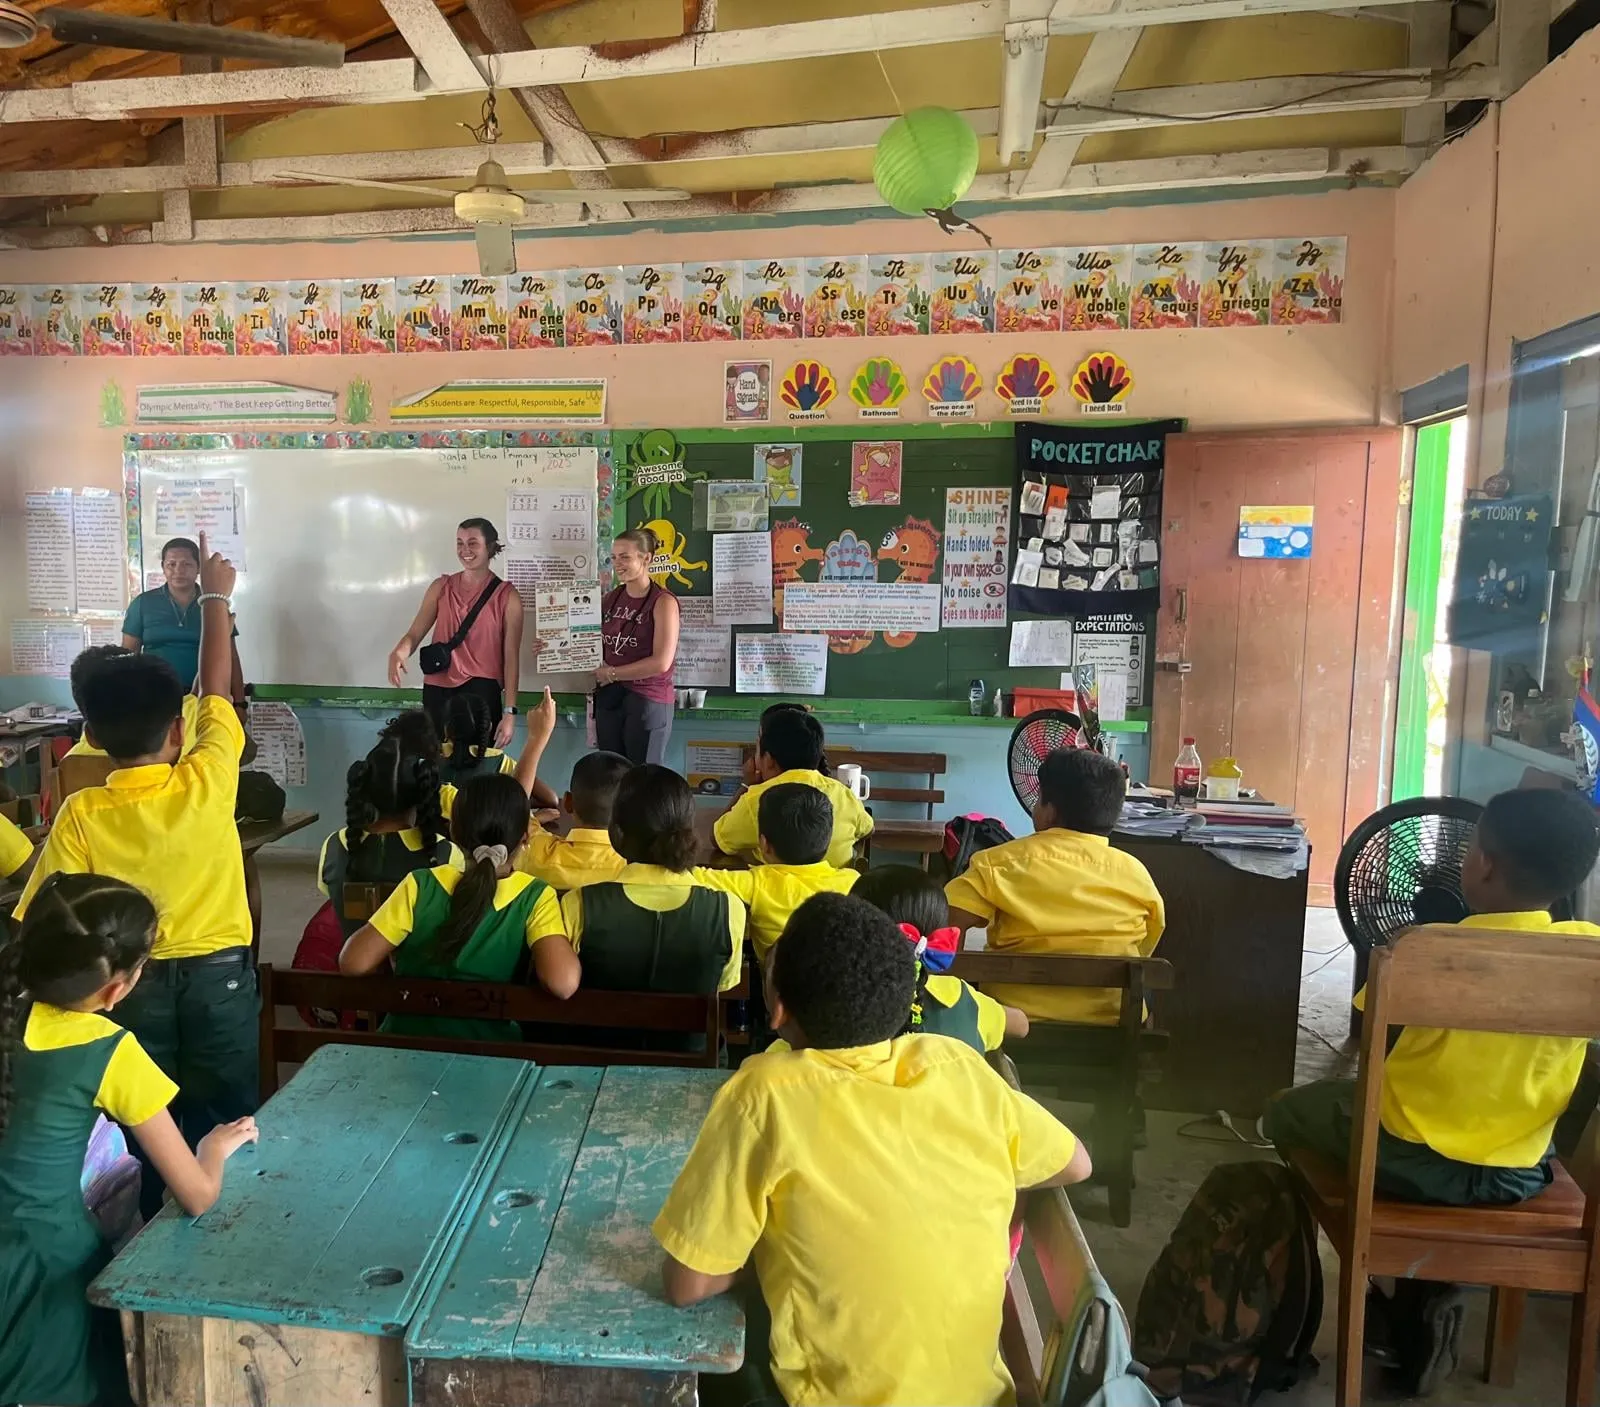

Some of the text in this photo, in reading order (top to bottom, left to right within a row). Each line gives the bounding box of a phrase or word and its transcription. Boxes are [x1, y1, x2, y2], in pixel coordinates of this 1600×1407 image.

[764, 262, 785, 278] Rr
[954, 258, 981, 275] Uu
[520, 277, 545, 292] Nn
[640, 268, 660, 291] Pp
[1291, 279, 1310, 293] Zz
[461, 279, 496, 295] Mm
[822, 286, 837, 300] Ss
[948, 286, 967, 300] Uu
[1013, 282, 1032, 296] Vv
[1074, 284, 1104, 298] Ww
[1150, 284, 1168, 298] Xx
[1217, 280, 1238, 298] Yy
[883, 290, 896, 304] Tt
[1312, 295, 1342, 308] zeta
[638, 296, 656, 312] Pp
[699, 302, 717, 318] Qq
[915, 303, 928, 316] te
[1041, 300, 1058, 310] ve
[1088, 298, 1126, 312] doble
[1162, 300, 1198, 315] equis
[1222, 296, 1270, 313] griega
[461, 305, 486, 318] Mm
[518, 306, 538, 319] Nn
[778, 311, 800, 322] ere
[841, 309, 865, 320] ese
[980, 306, 988, 316] u
[1138, 312, 1154, 323] 24
[1208, 310, 1223, 320] 25
[1279, 308, 1296, 319] 26
[146, 312, 162, 327] Gg
[193, 315, 209, 327] Hh
[298, 309, 317, 328] Jj
[357, 316, 372, 329] Kk
[610, 319, 617, 329] o
[664, 310, 680, 327] pe
[726, 313, 740, 326] cu
[1070, 314, 1084, 324] 23
[1088, 313, 1104, 323] ve
[18, 326, 31, 338] de
[47, 320, 59, 332] Ee
[380, 326, 394, 339] ka
[432, 323, 450, 336] ele
[480, 323, 506, 334] eme
[811, 325, 826, 337] 19
[73, 333, 80, 342] e
[114, 330, 132, 341] efe
[168, 331, 182, 343] ge
[200, 327, 234, 341] hache
[312, 328, 338, 344] jota
[459, 339, 471, 350] 13
[739, 378, 756, 391] Hand
[430, 399, 462, 407] Students
[479, 399, 520, 408] Respectful,
[522, 398, 567, 408] Responsible,
[568, 398, 586, 406] Safe
[736, 392, 758, 405] Signals
[140, 402, 172, 413] Olympic
[235, 400, 252, 408] Best
[254, 400, 274, 410] Keep
[275, 399, 304, 410] Getting
[1090, 404, 1106, 412] need
[1107, 404, 1122, 412] help
[438, 448, 581, 464] Santa Elena Primary School
[1030, 438, 1162, 464] POCKET CHAR
[638, 461, 683, 474] Awesome
[954, 490, 1004, 504] SHINE
[948, 508, 994, 527] Sit up straight
[1486, 506, 1522, 520] TODAY
[946, 536, 967, 552] Hands
[654, 554, 670, 562] ops
[648, 562, 680, 573] arning)
[944, 560, 950, 576] In
[950, 562, 963, 581] your
[964, 564, 975, 576] own
[976, 563, 992, 581] space
[944, 585, 980, 598] No noise
[944, 606, 1005, 623] Eyes on the speaker
